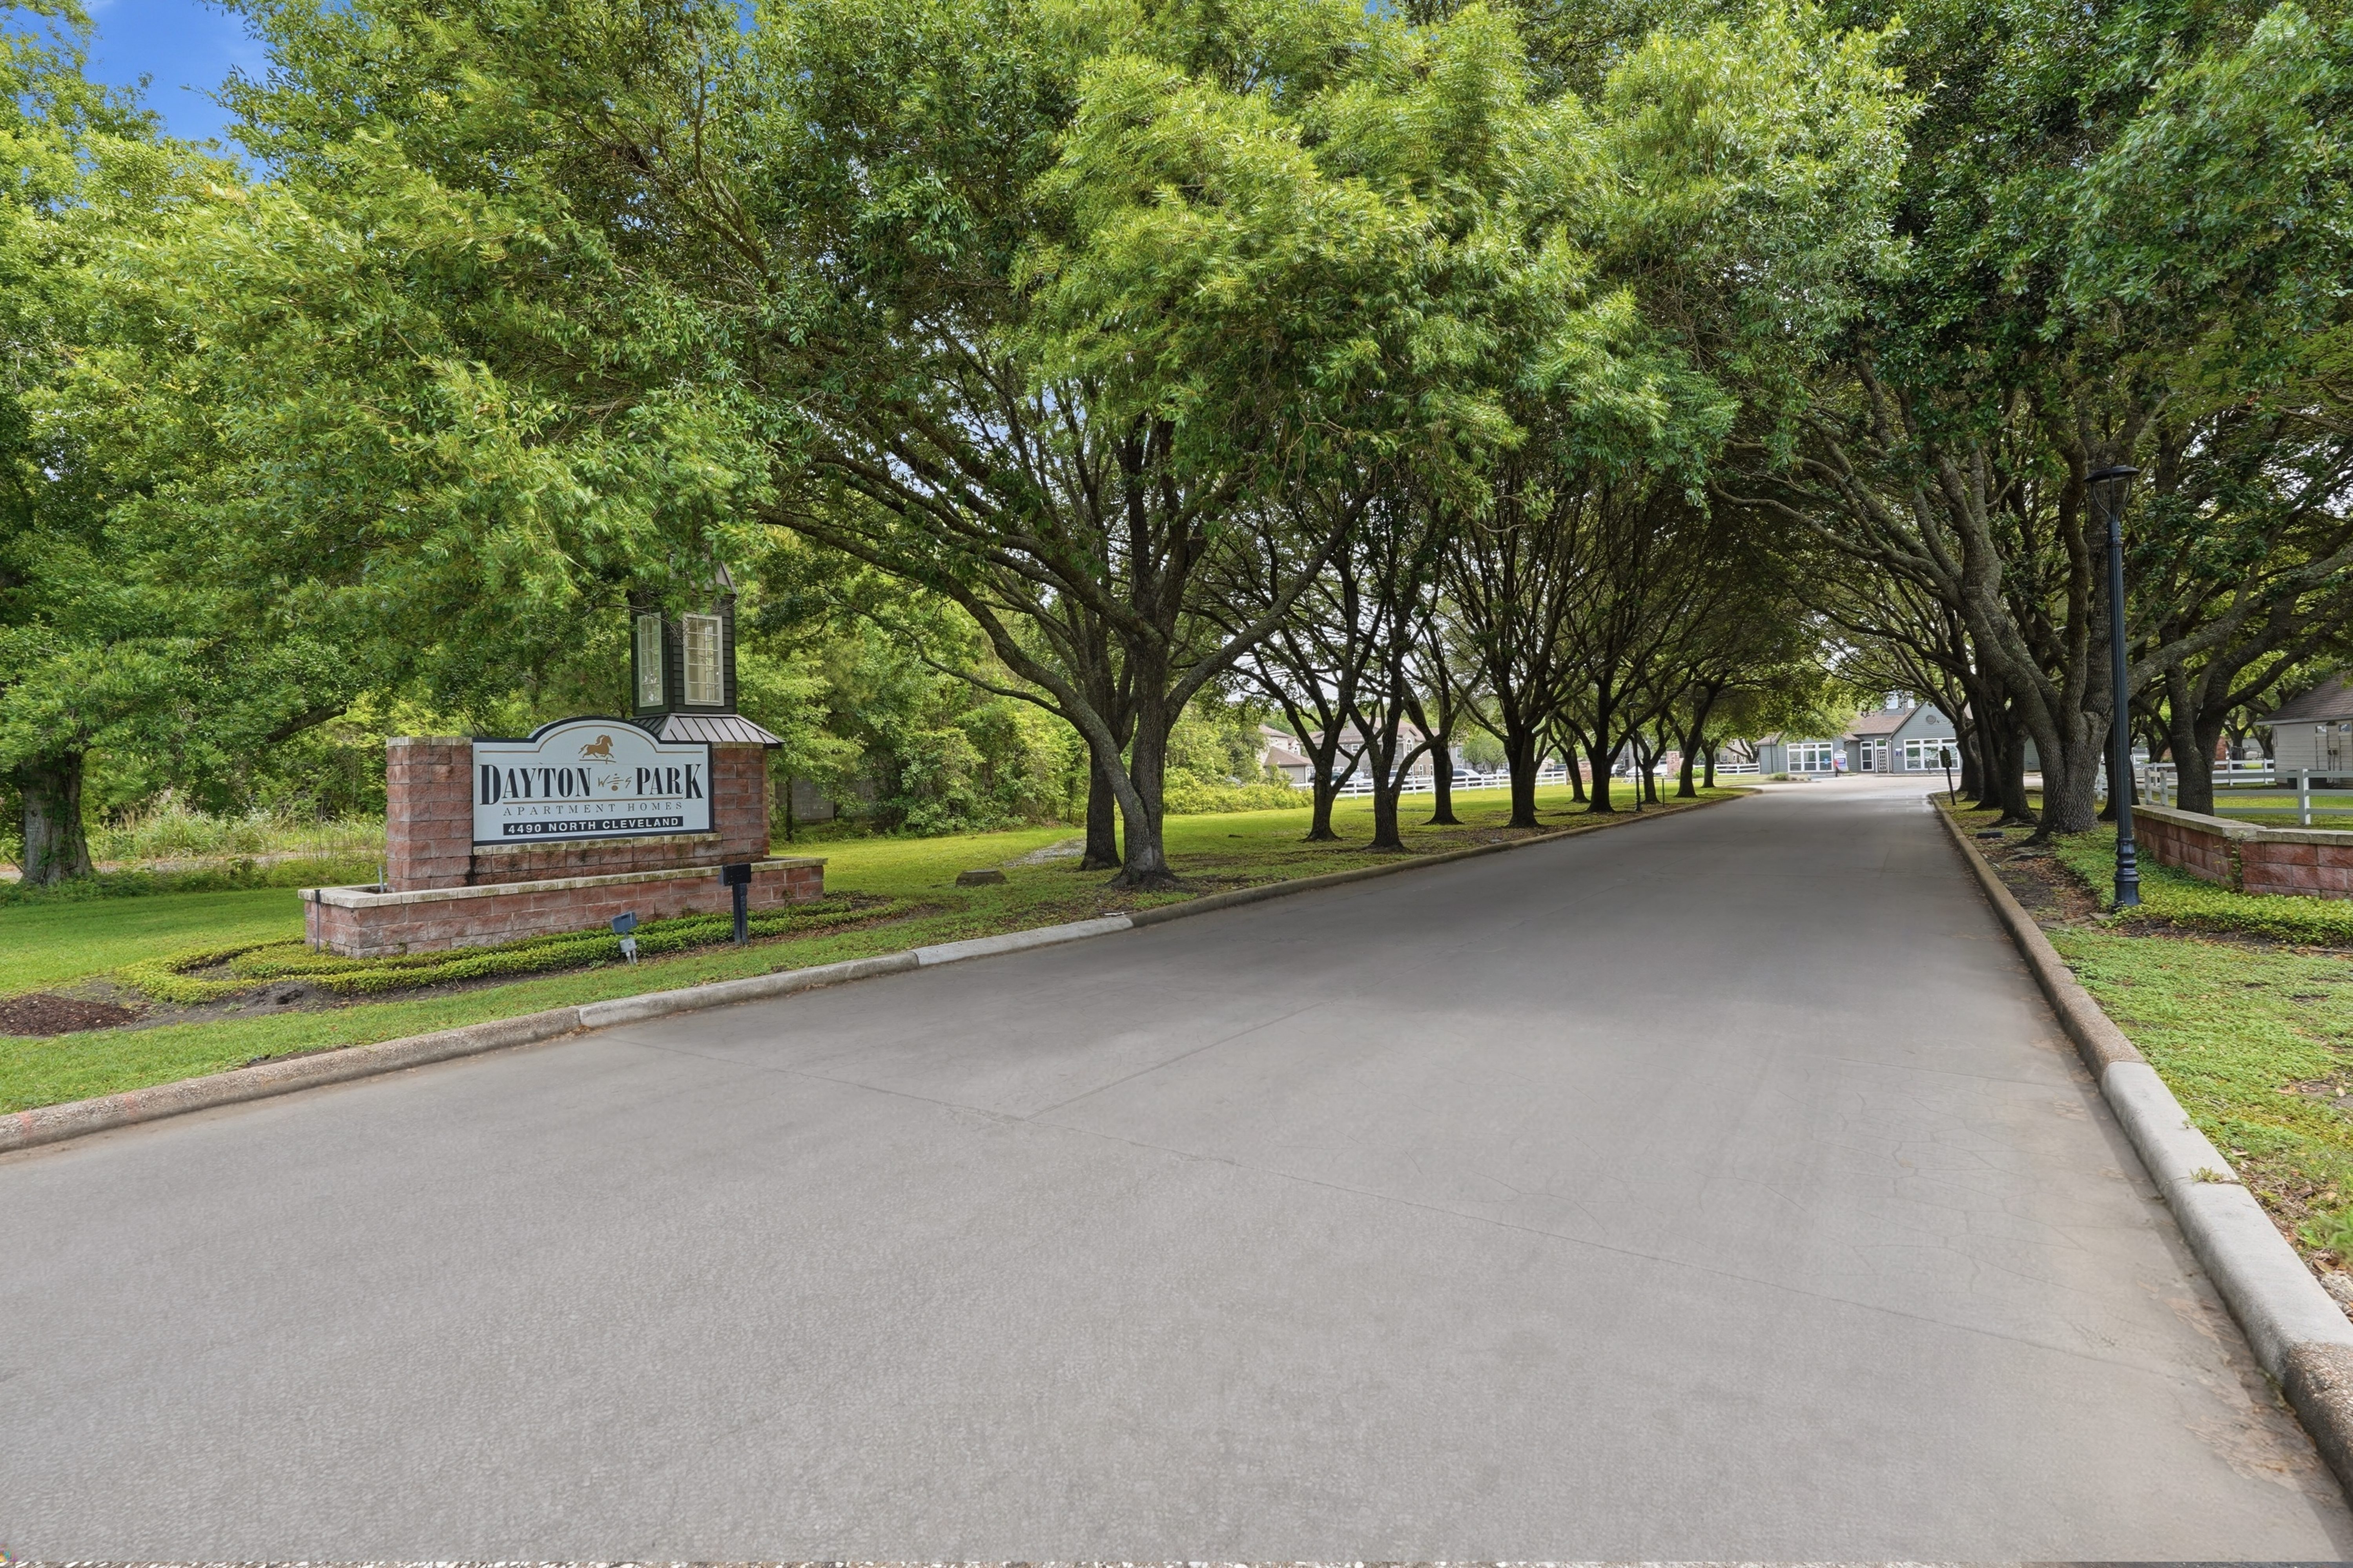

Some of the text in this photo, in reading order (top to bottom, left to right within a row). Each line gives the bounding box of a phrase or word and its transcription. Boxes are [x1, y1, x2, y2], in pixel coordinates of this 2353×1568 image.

[479, 764, 704, 805] DAYTON PARK
[503, 802, 682, 816] APARTMENT HOMES
[509, 818, 678, 834] 4490 NORTH CLEVELAND
